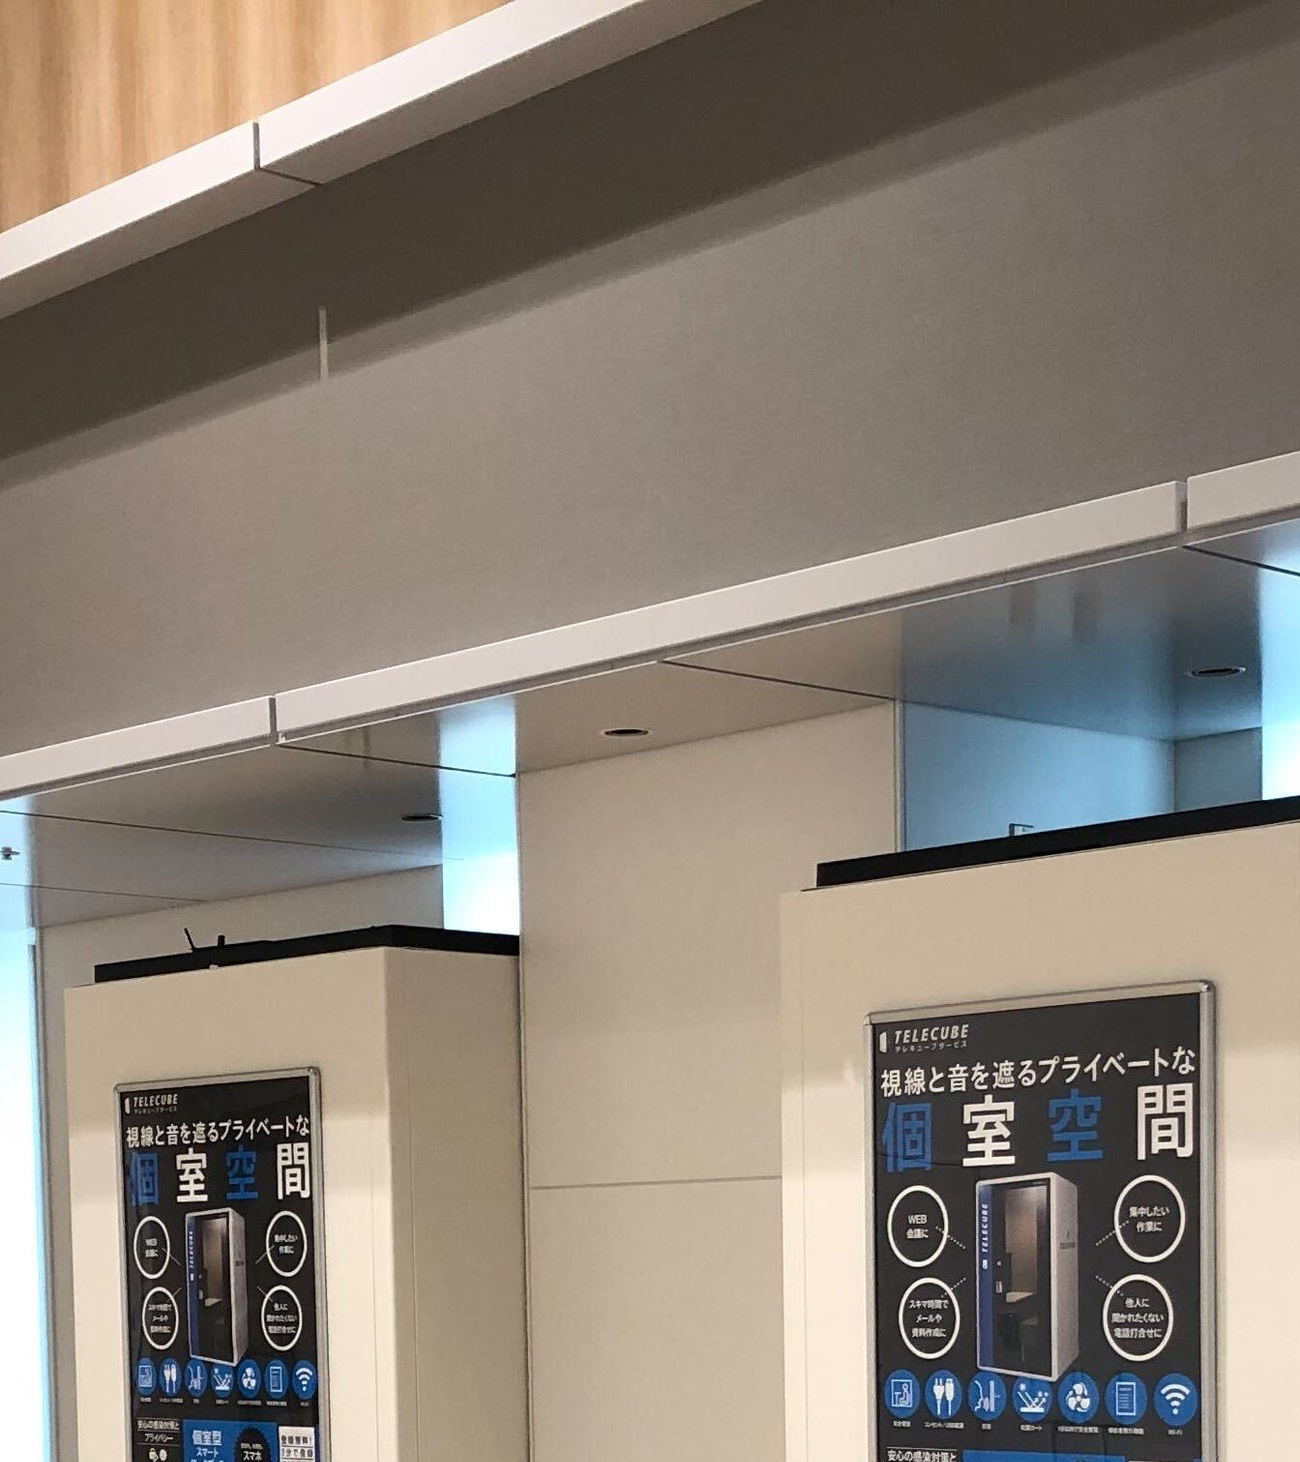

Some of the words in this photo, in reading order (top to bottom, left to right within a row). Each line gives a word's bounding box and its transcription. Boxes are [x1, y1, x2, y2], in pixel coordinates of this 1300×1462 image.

[894, 1024, 969, 1044] TELECUBE
[880, 1046, 1196, 1097] 視線と音を遮るプライベートな
[133, 1093, 178, 1107] TELECUBE
[126, 1114, 310, 1148] 視線と音を遮るプライベートな
[882, 1082, 1194, 1173] 個室空間
[129, 1142, 311, 1206] 個室空間
[1129, 1205, 1169, 1218] 集中したい
[907, 1214, 927, 1225] WEB
[1136, 1221, 1162, 1232] 作業に
[1125, 1298, 1149, 1308] 他人に
[916, 1314, 942, 1323] メールや
[196, 1447, 220, 1458] スマート
[243, 1451, 262, 1461] スマホ
